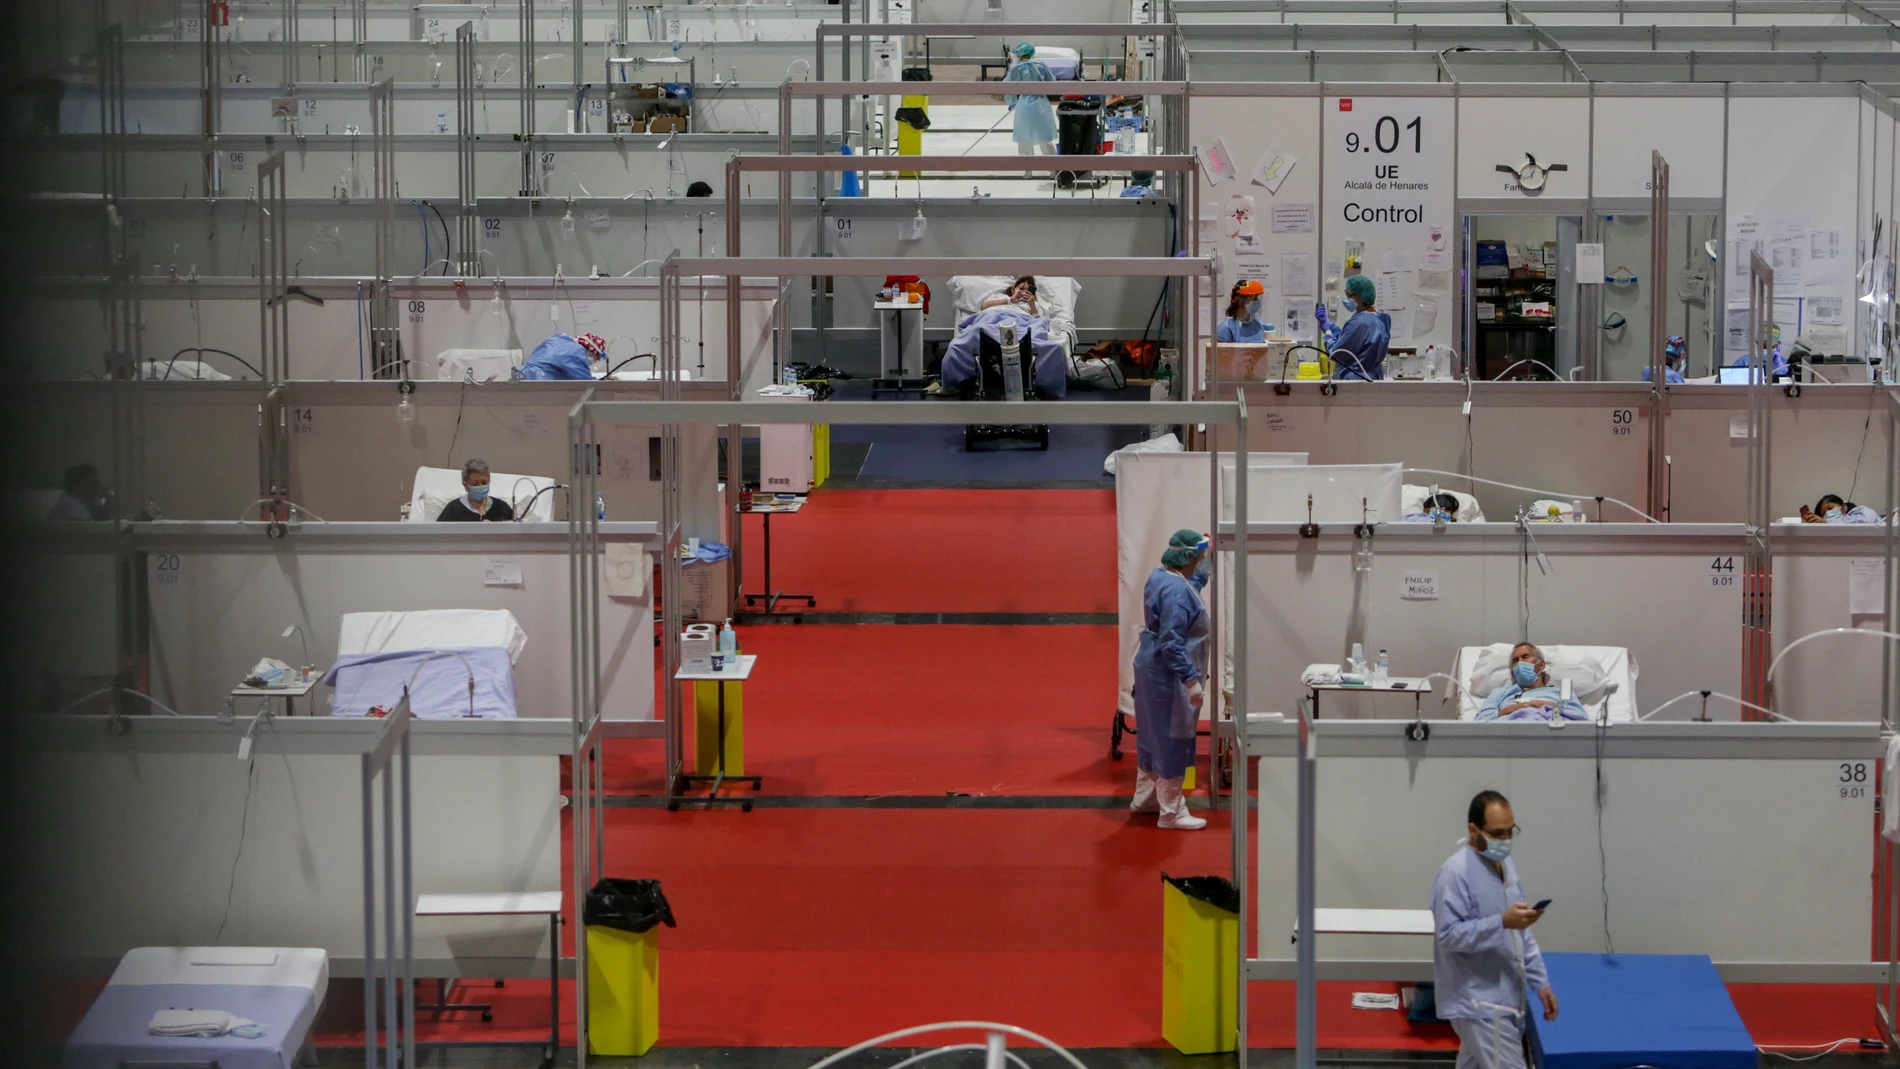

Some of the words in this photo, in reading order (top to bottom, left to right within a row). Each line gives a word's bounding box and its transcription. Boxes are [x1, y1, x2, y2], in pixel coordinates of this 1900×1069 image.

[187, 19, 198, 27] 23
[428, 19, 439, 27] 24
[373, 56, 384, 65] 18
[305, 99, 316, 109] 12
[590, 100, 603, 109] 13
[1345, 115, 1421, 154] 9.01
[230, 153, 244, 163] 06
[541, 153, 555, 163] 07
[1375, 165, 1399, 179] UE
[1344, 181, 1373, 190] Alcalá
[1375, 181, 1387, 190] de
[1389, 182, 1429, 190] Henares
[1343, 203, 1423, 223] Control
[485, 218, 500, 230] 02
[837, 218, 851, 230] 01
[408, 301, 425, 313] 08
[294, 408, 312, 422] 14
[1612, 410, 1632, 424] 50
[1613, 427, 1631, 435] 9.01
[158, 555, 180, 570] 20
[1711, 557, 1734, 572] 44
[158, 575, 178, 583] 9.01
[1712, 577, 1732, 586] 9.01
[1839, 763, 1866, 782] 38
[1840, 788, 1864, 798] 9.01
